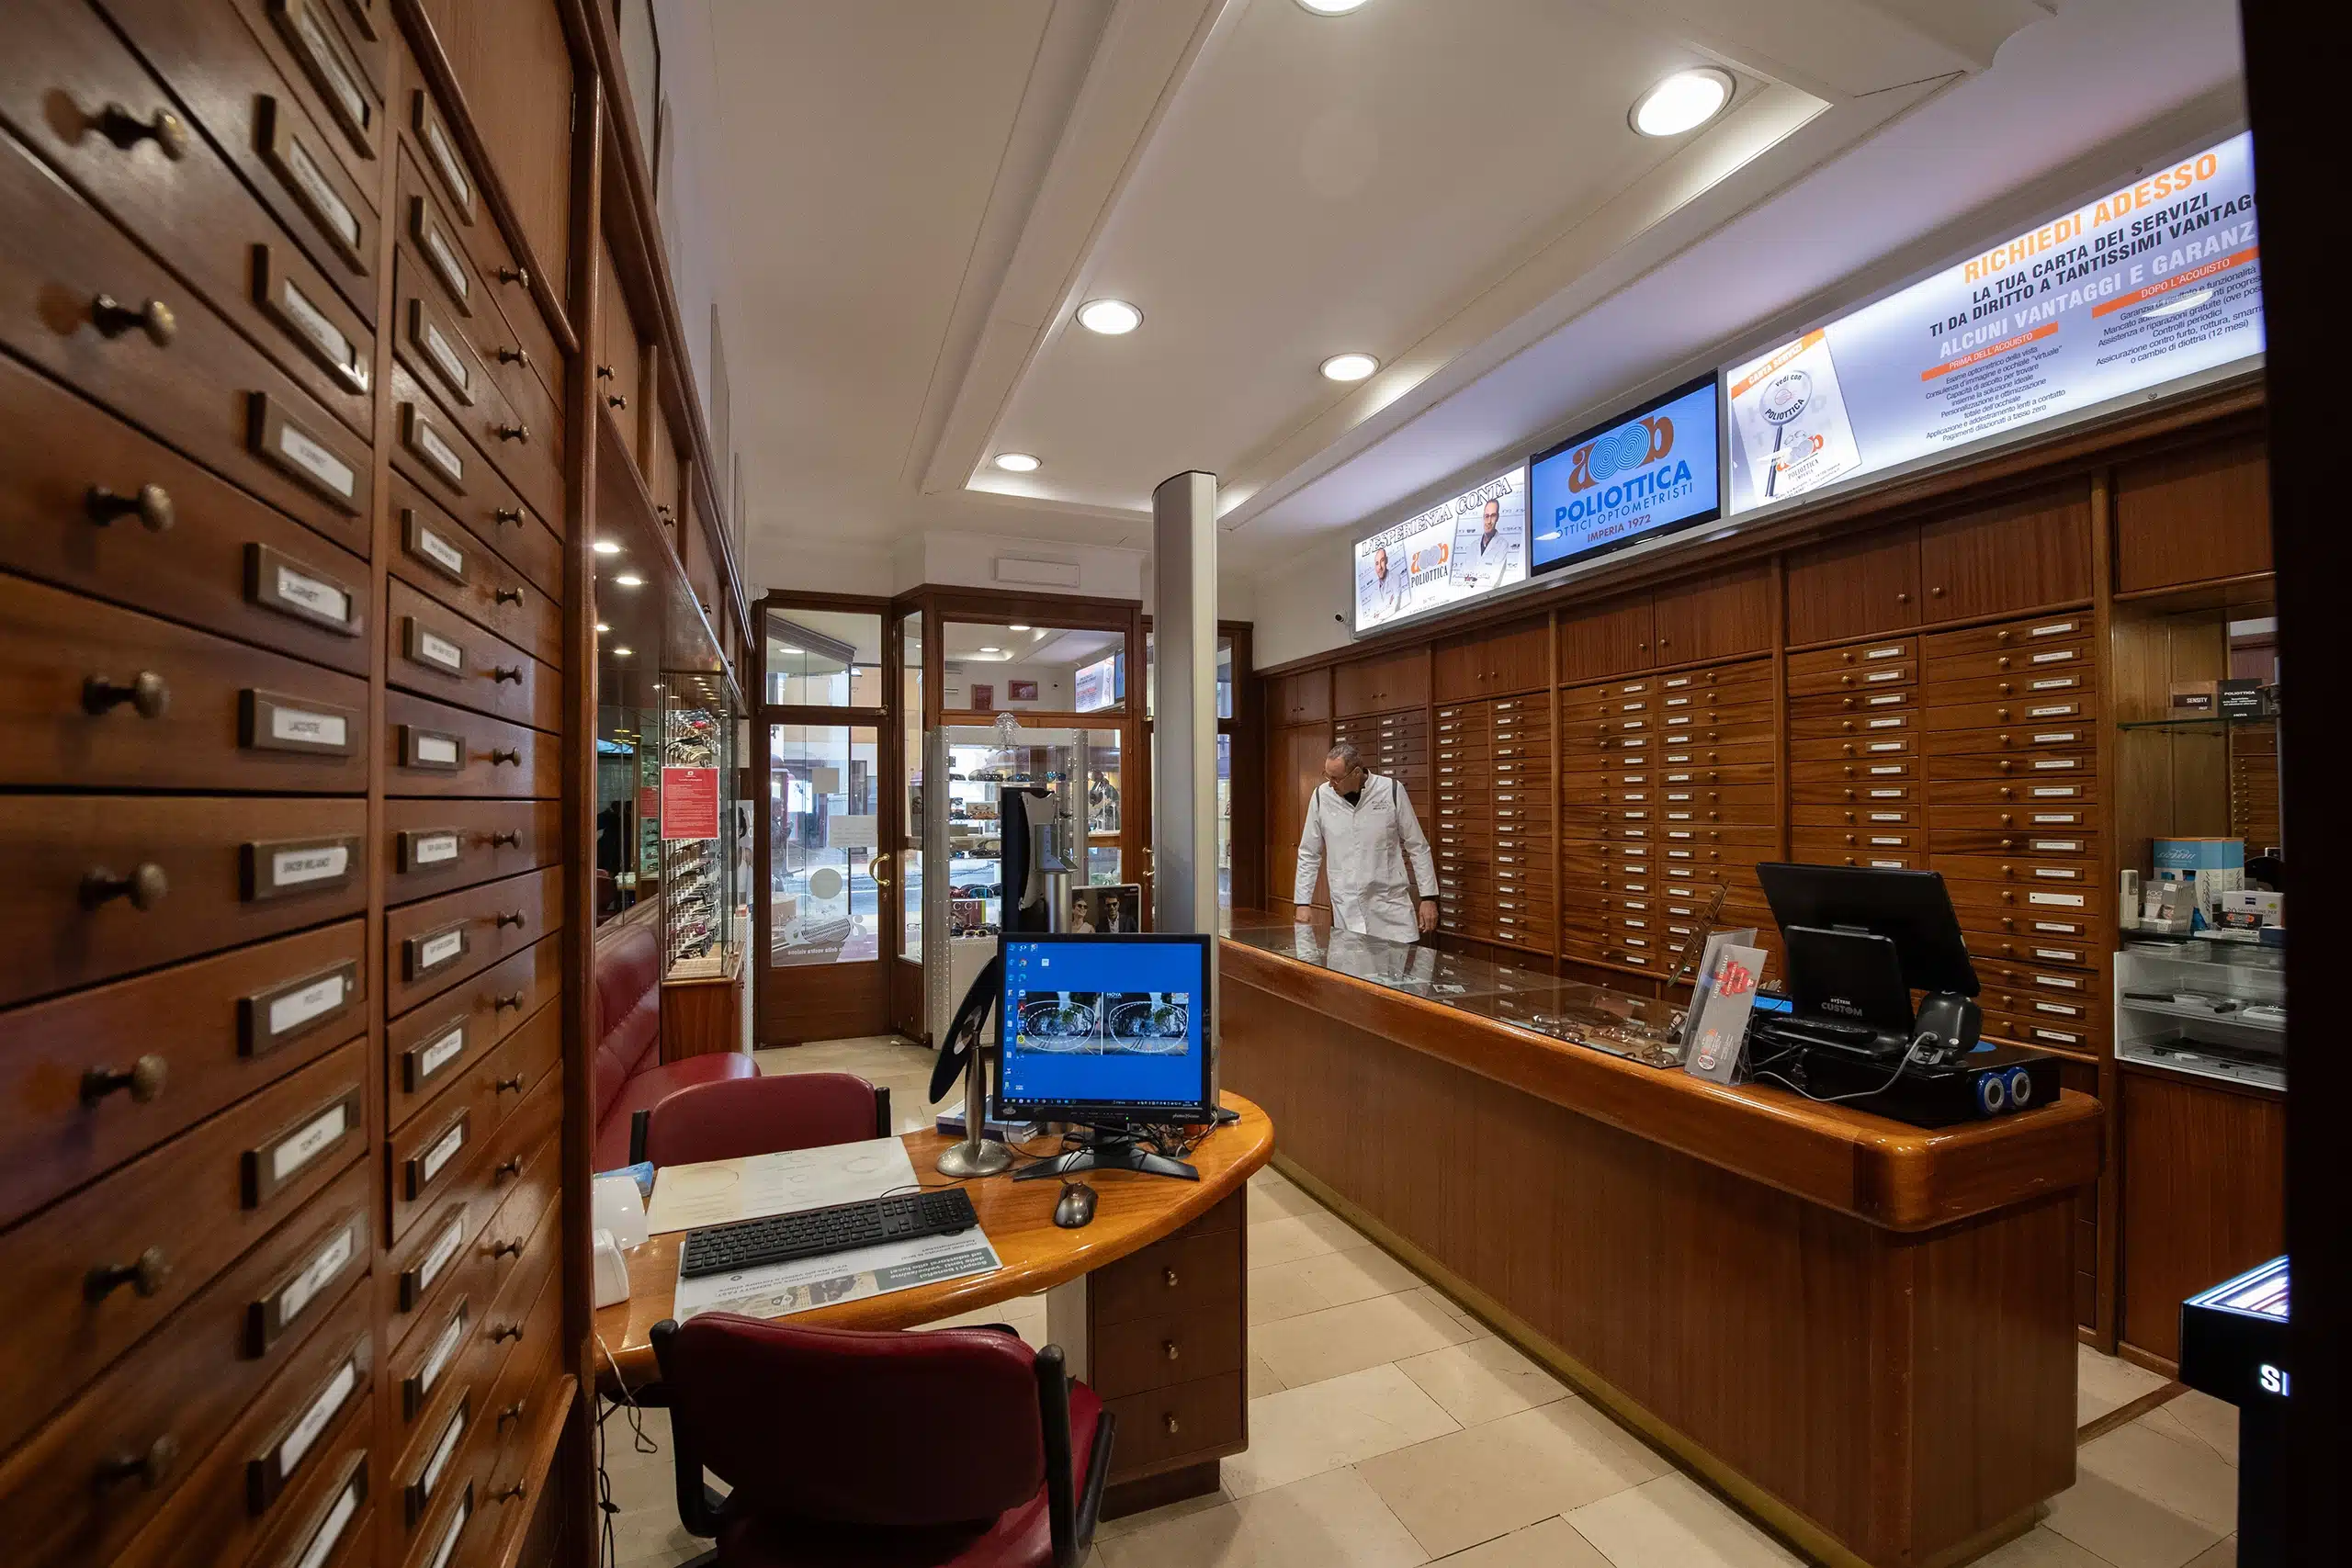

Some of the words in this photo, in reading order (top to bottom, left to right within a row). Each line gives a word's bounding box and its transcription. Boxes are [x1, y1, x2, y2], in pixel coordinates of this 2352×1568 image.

[1964, 214, 2082, 284] RICHIEDI
[2094, 154, 2216, 228] ADESSO
[1930, 322, 1943, 337] TI
[1949, 313, 1968, 331] DA
[1973, 284, 2033, 321] DIRITTO
[2040, 278, 2051, 293] A
[2056, 231, 2162, 286] TANTISSIMI
[2168, 194, 2256, 239] VANTAG
[1973, 287, 1991, 304] LA
[1996, 272, 2027, 293] TUA
[2032, 244, 2088, 279] CARTA
[2095, 229, 2124, 253] DEI
[2132, 192, 2209, 236] SERVIZI
[1940, 318, 2008, 359] ALCUNI
[2015, 273, 2121, 329] VANTAGGI
[2130, 265, 2143, 285] E
[2153, 220, 2256, 275] GARANZ
[2120, 303, 2154, 321] Garanzia
[2206, 265, 2256, 289] funzionalità
[2141, 281, 2168, 299] DOPO
[2171, 258, 2230, 287] L'ACQUISTO
[2098, 328, 2138, 347] Assistenza
[2146, 310, 2188, 331] riparazioni
[2188, 298, 2222, 317] gratuite
[2223, 291, 2242, 305] (ove
[2103, 319, 2137, 336] Mancato
[2152, 321, 2186, 338] Controlli
[2187, 308, 2222, 327] periodici
[1949, 355, 1973, 370] PRIMA
[1973, 333, 2033, 360] DELL'ACQUISTO
[2096, 344, 2148, 367] Assicurazione
[2149, 334, 2175, 348] contro
[2176, 327, 2199, 340] furto,
[2199, 316, 2231, 331] rottura,
[2137, 346, 2167, 362] cambio
[2168, 343, 2177, 352] di
[2177, 333, 2207, 349] diottria
[2208, 327, 2223, 339] (12
[2224, 319, 2249, 333] mesi)
[1775, 374, 1789, 387] vedi
[1926, 384, 1960, 400] Consulenza
[2003, 357, 2030, 372] occhiale
[1946, 372, 1967, 384] Esame
[2005, 352, 2021, 362] della
[2021, 346, 2038, 356] vista
[1973, 383, 1979, 391] di
[2004, 372, 2015, 382] per
[2016, 363, 2040, 376] trovare
[1765, 398, 1804, 421] POLIOTTICA
[2037, 389, 2066, 403] contatto
[1555, 459, 1692, 528] POLIOTTICA
[1556, 518, 1591, 539] OTTICI
[1598, 482, 1693, 525] OPTOMETRISTI
[1362, 504, 1453, 558] L'ESPERIENZA
[1455, 477, 1512, 515] CONTA
[1588, 522, 1624, 543] IMPERIA
[1628, 513, 1651, 530] 1972
[1411, 566, 1449, 588] POLIOTTICA
[953, 901, 978, 911] CCI
[1821, 1001, 1863, 1017] CUSTOM
